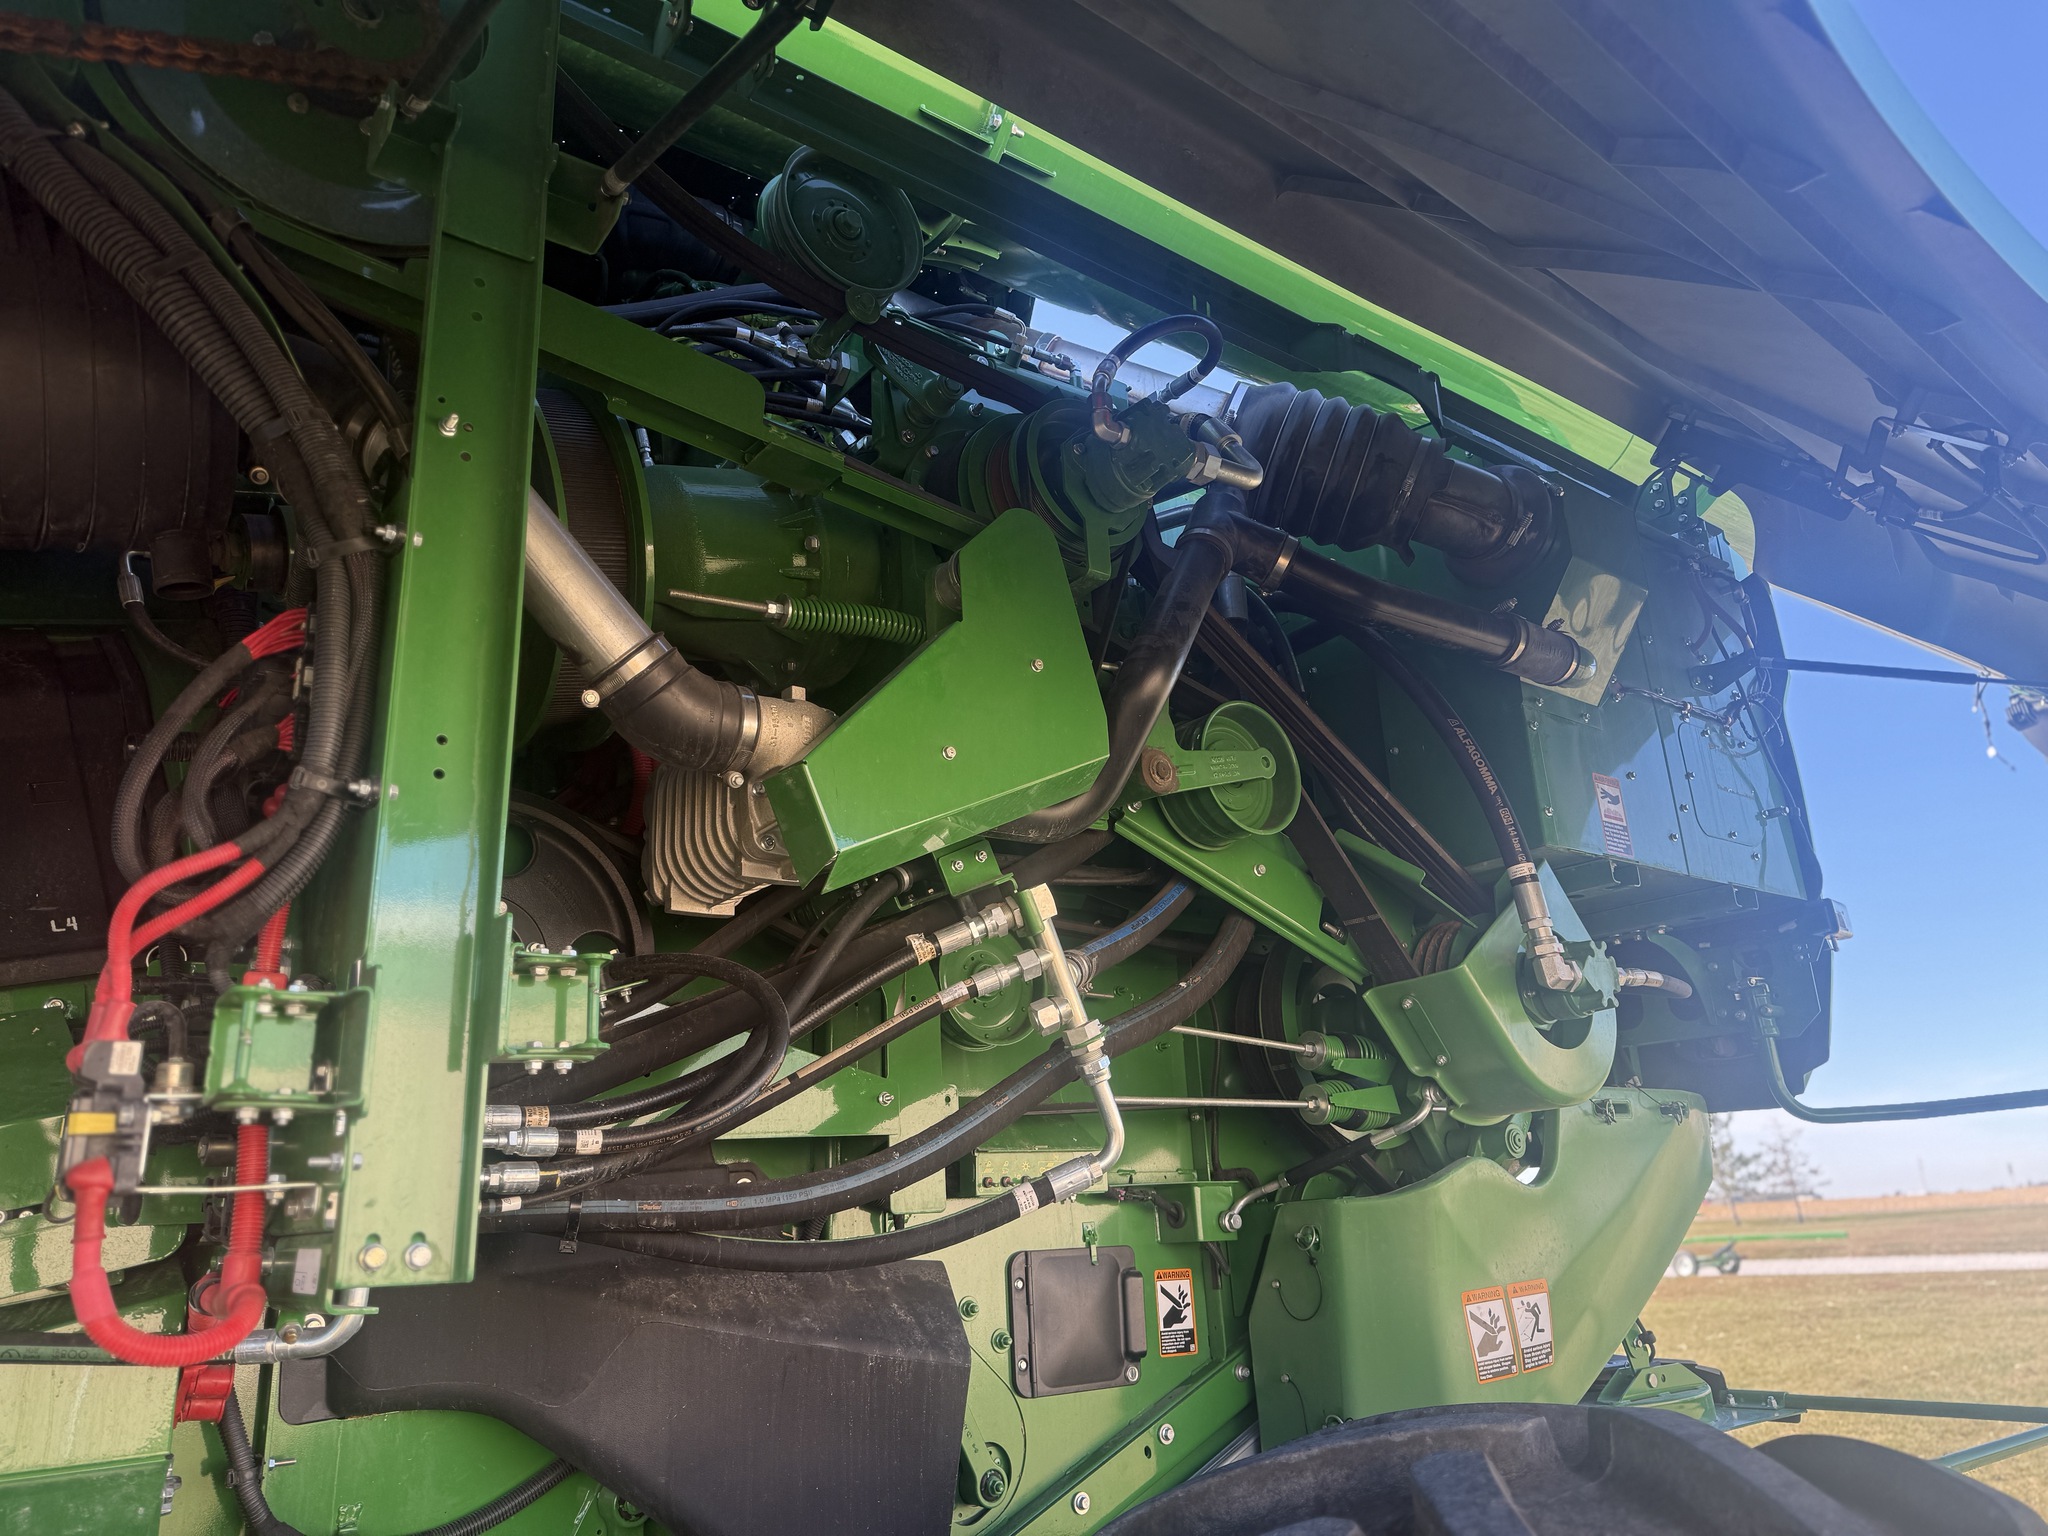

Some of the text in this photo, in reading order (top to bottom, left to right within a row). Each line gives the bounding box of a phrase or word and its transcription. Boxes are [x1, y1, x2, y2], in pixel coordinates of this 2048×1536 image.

[1454, 726, 1499, 796] ALFAGOMMA
[1500, 808, 1513, 825] 604
[1507, 826, 1517, 837] 14
[1512, 837, 1522, 852] bar
[50, 916, 78, 932] L4
[527, 1108, 533, 1117] NO
[765, 1195, 781, 1204] MPa
[782, 1191, 798, 1202] (150
[798, 1188, 814, 1199] PSI)
[1162, 1271, 1190, 1279] WARNING
[1519, 1282, 1545, 1293] WARNING
[1471, 1289, 1501, 1301] WARNING
